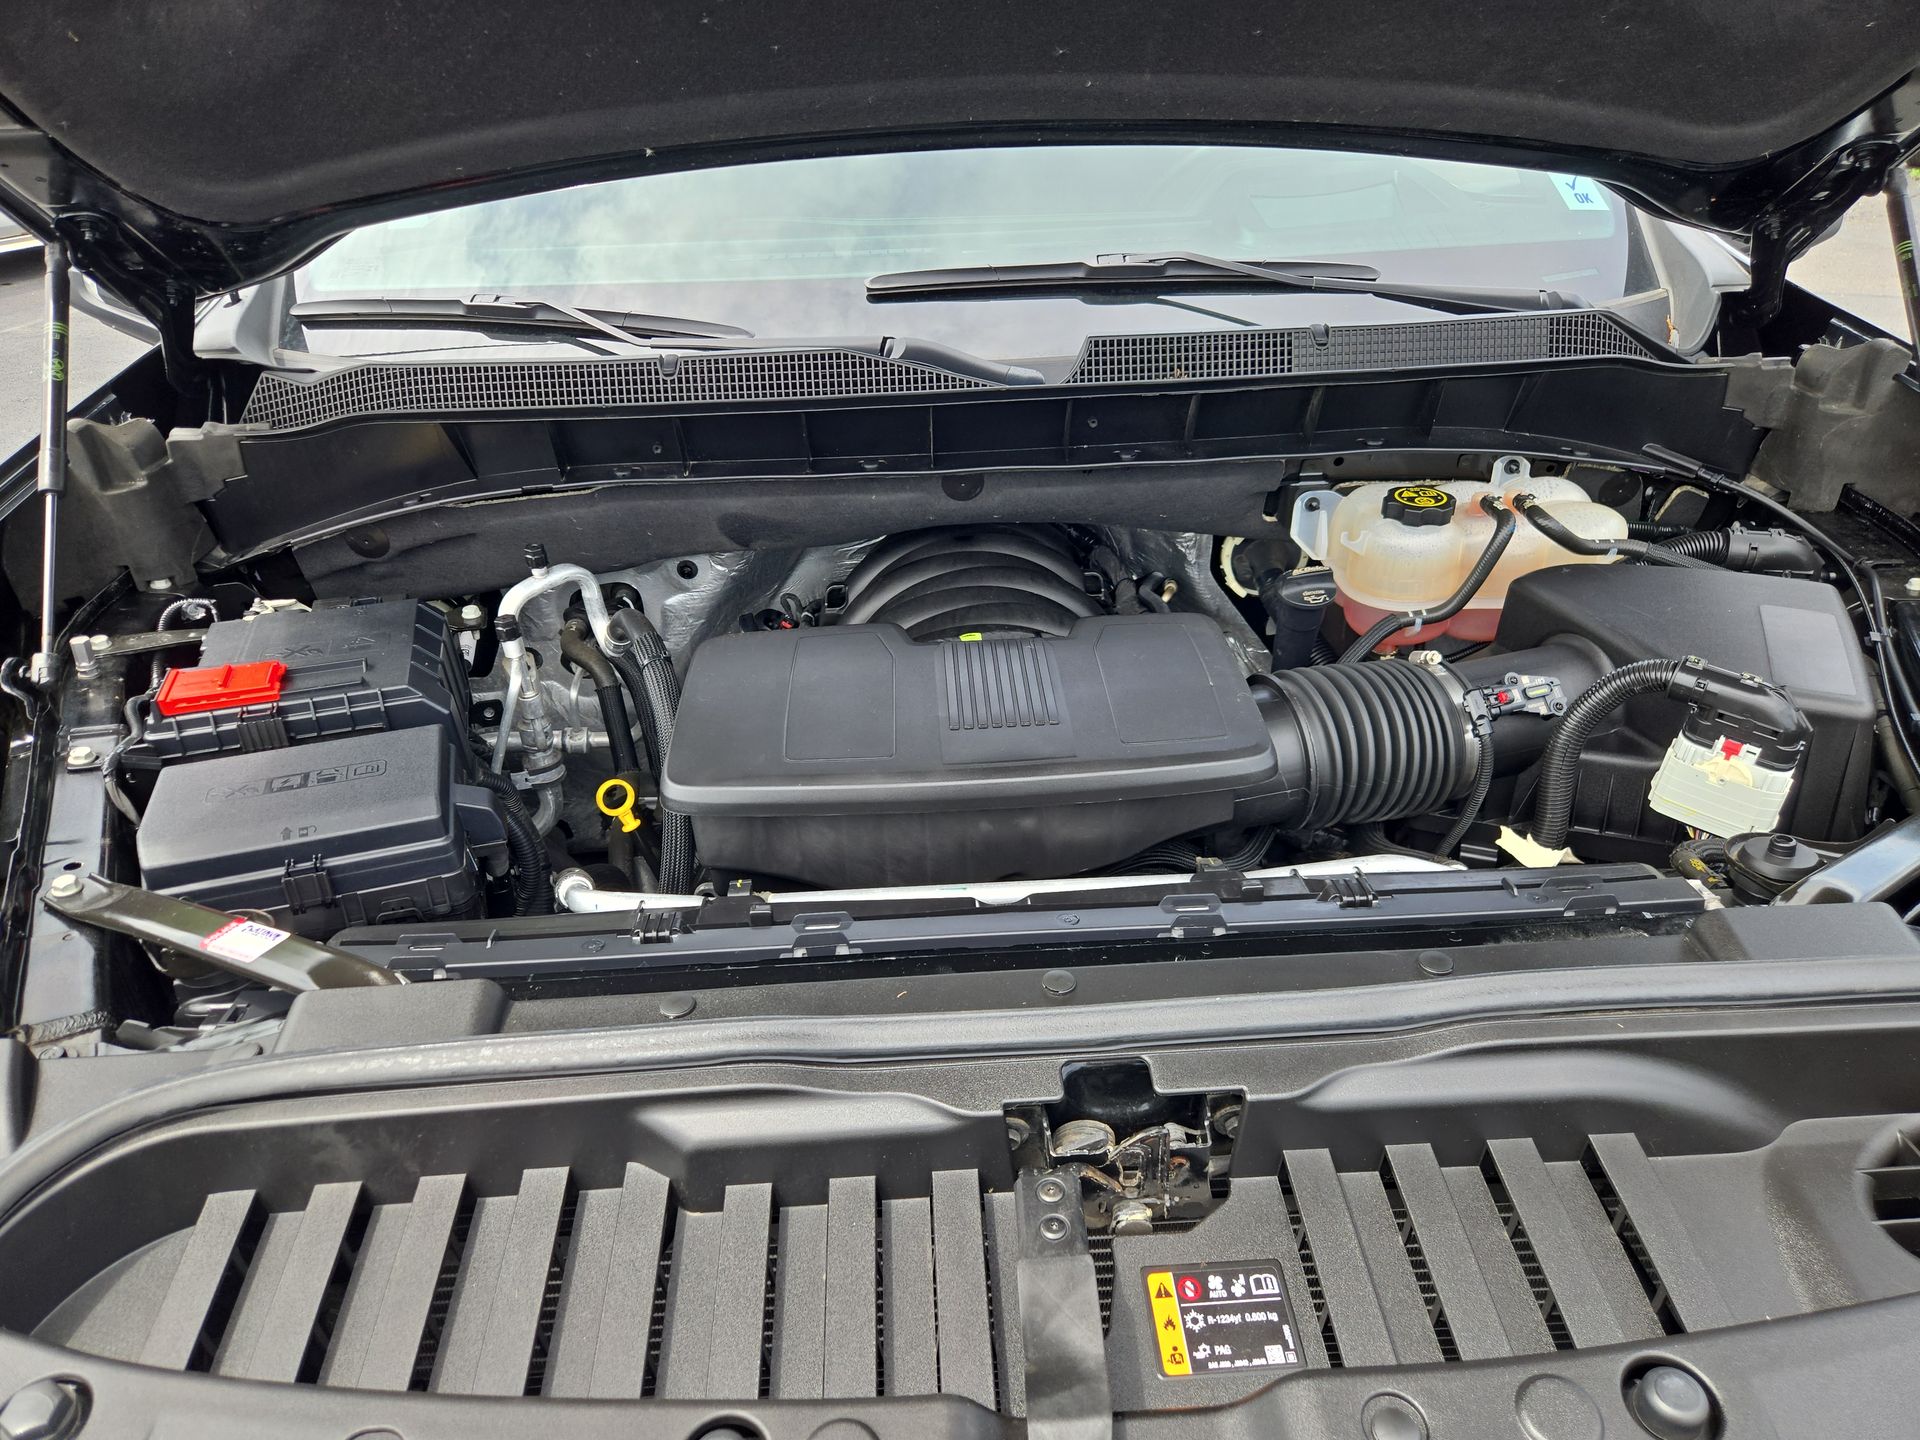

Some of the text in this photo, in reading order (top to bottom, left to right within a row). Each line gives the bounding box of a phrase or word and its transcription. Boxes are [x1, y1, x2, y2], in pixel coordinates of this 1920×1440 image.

[1574, 193, 1594, 204] OK
[1209, 1290, 1227, 1298] AUTO
[1207, 1313, 1241, 1324] R-1234yf
[1267, 1311, 1279, 1321] kg
[1214, 1345, 1232, 1356] PAG
